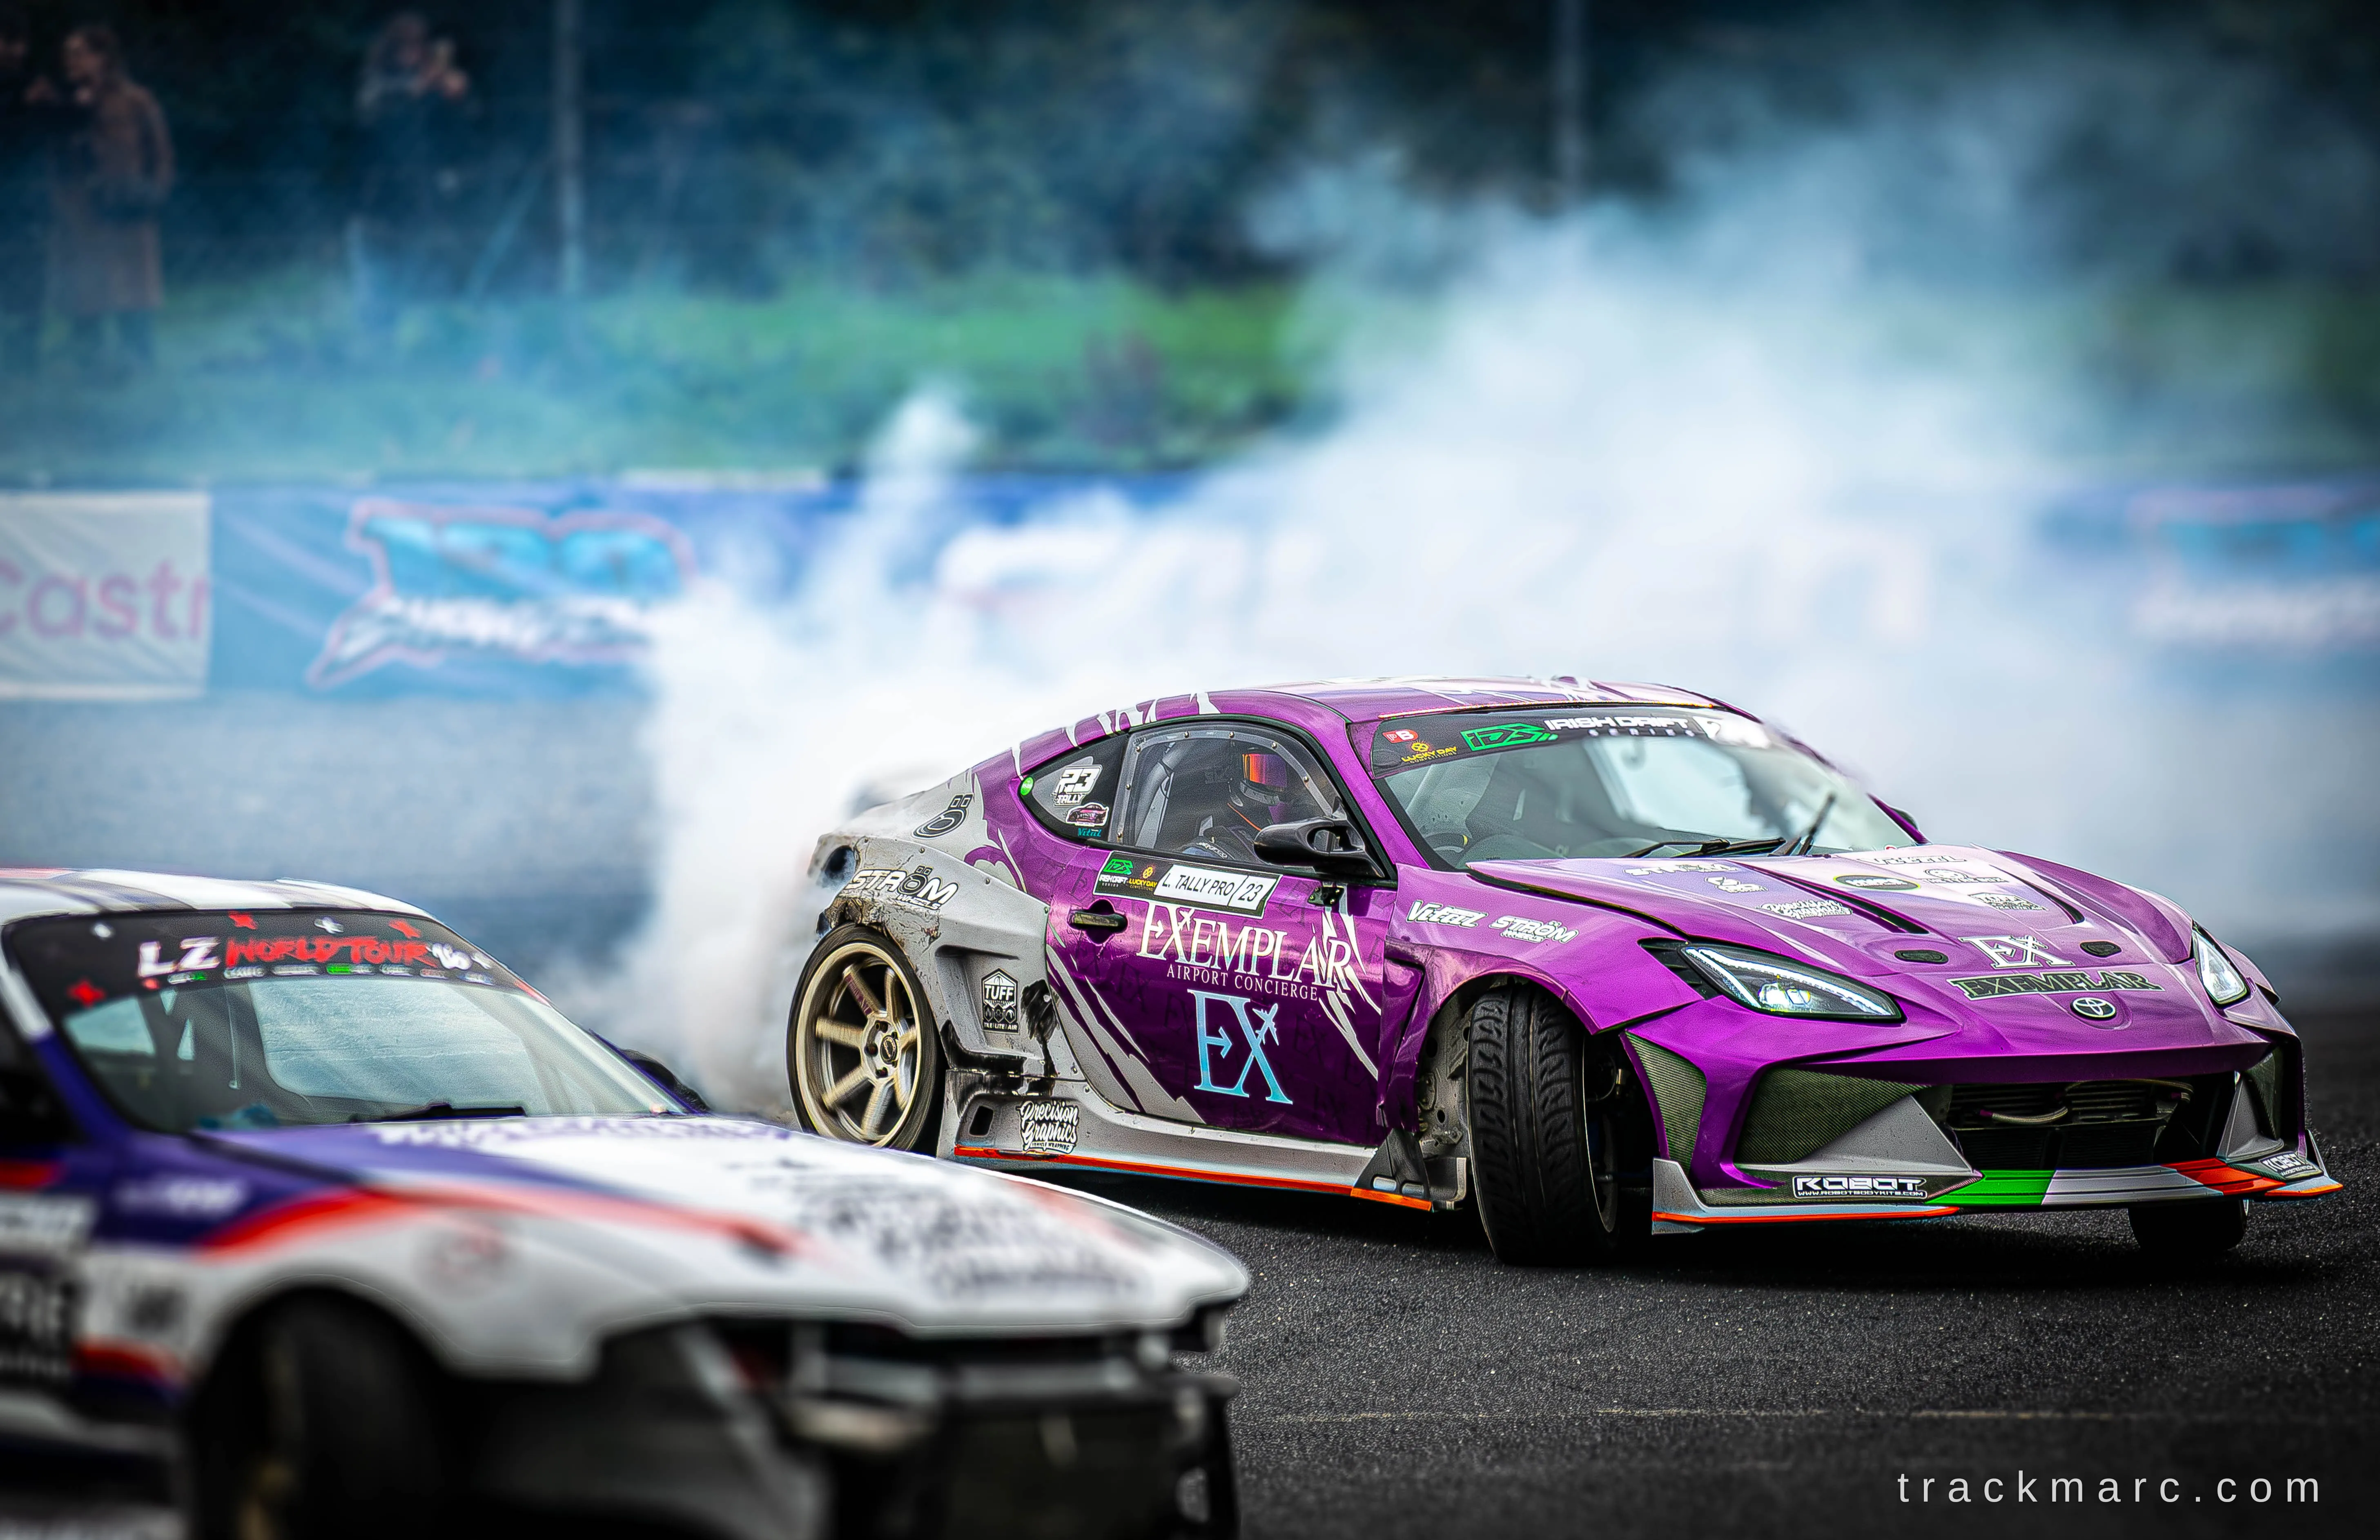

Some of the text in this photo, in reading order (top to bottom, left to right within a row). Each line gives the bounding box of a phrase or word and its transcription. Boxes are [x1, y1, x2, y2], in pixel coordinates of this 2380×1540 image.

[1544, 716, 1688, 731] IRISH DRIFT
[1402, 746, 1457, 762] LUCKY DAY
[1054, 768, 1100, 793] 23
[1057, 794, 1084, 804] TALLY
[1162, 873, 1263, 902] L. TALLY PRO 23
[898, 894, 941, 910] WHEELS
[138, 936, 221, 977] LZ
[338, 936, 439, 967] TOUR
[1136, 901, 1351, 990] EXEMPLAR
[985, 985, 1014, 1001] TUFF
[1167, 964, 1318, 1001] AIRPORT CONCIERGE
[1955, 971, 2164, 999] EXEMPLAR
[1188, 989, 1293, 1104] EX
[1017, 1101, 1078, 1130] Precision
[1022, 1120, 1077, 1150] Graphics
[1797, 1177, 1923, 1191] ROBOT
